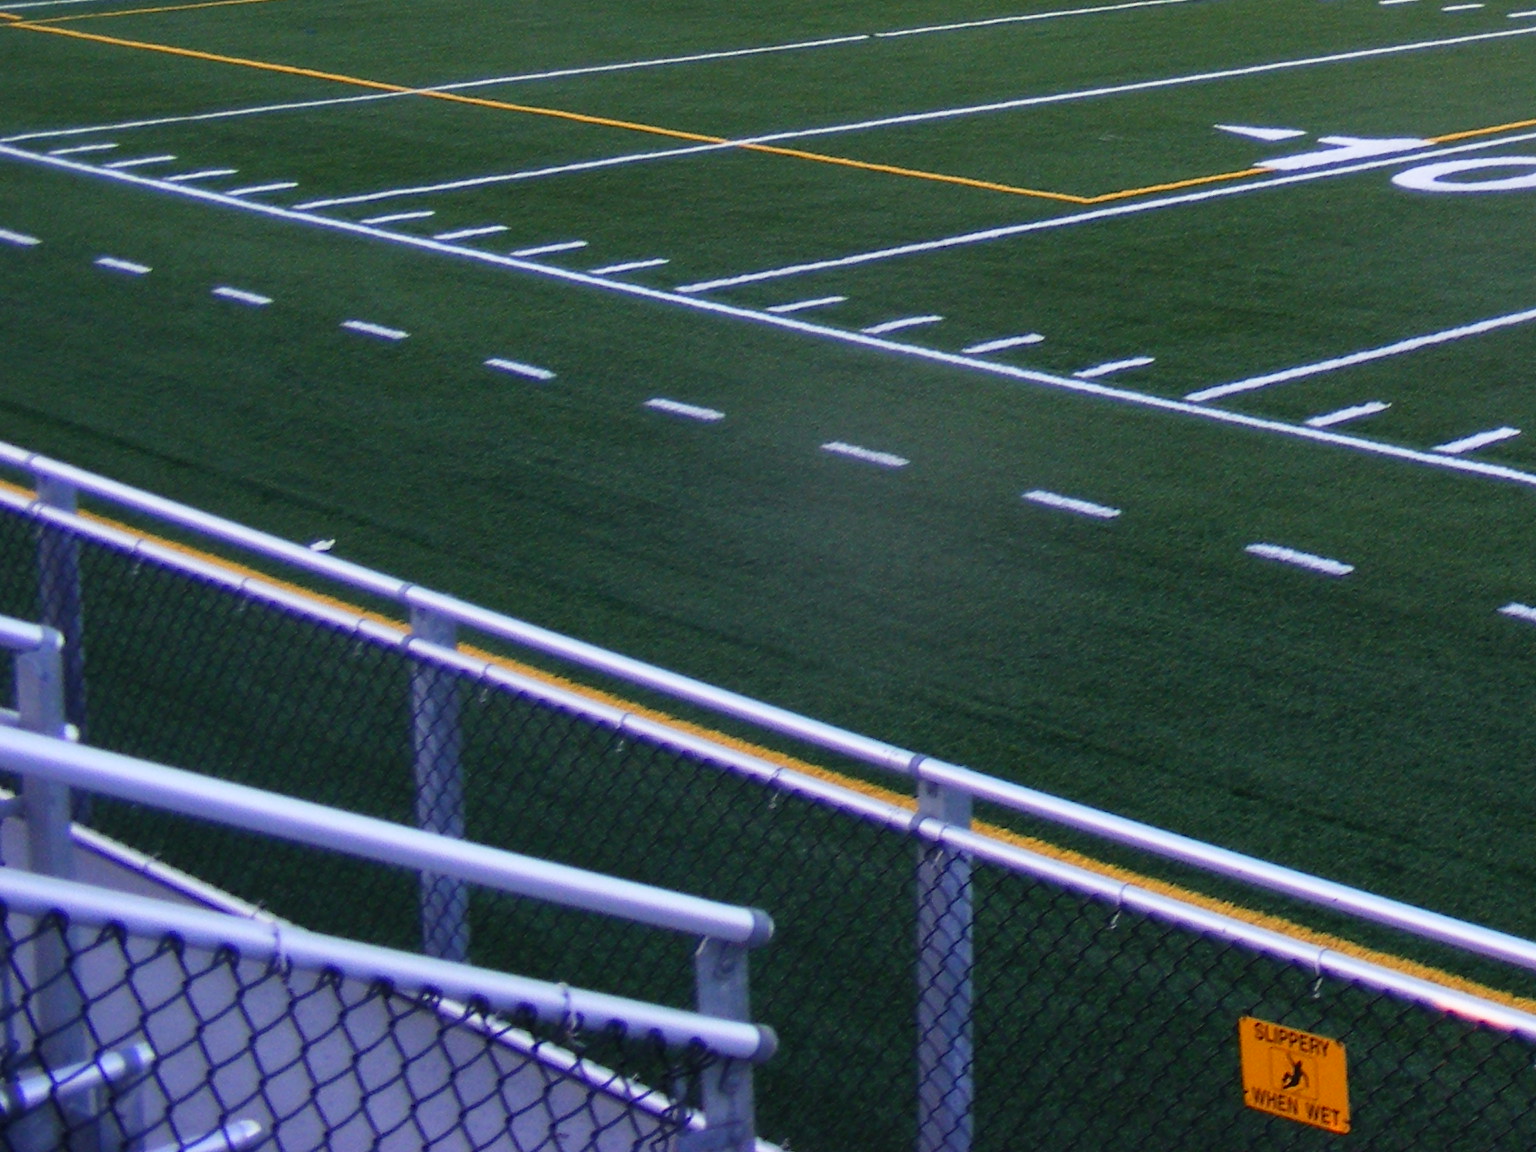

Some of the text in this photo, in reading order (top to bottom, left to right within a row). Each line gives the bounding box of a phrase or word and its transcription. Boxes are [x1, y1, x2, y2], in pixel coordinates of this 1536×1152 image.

[1254, 1022, 1329, 1057] SLIPPERY
[1251, 1087, 1340, 1126] WHEN WET
